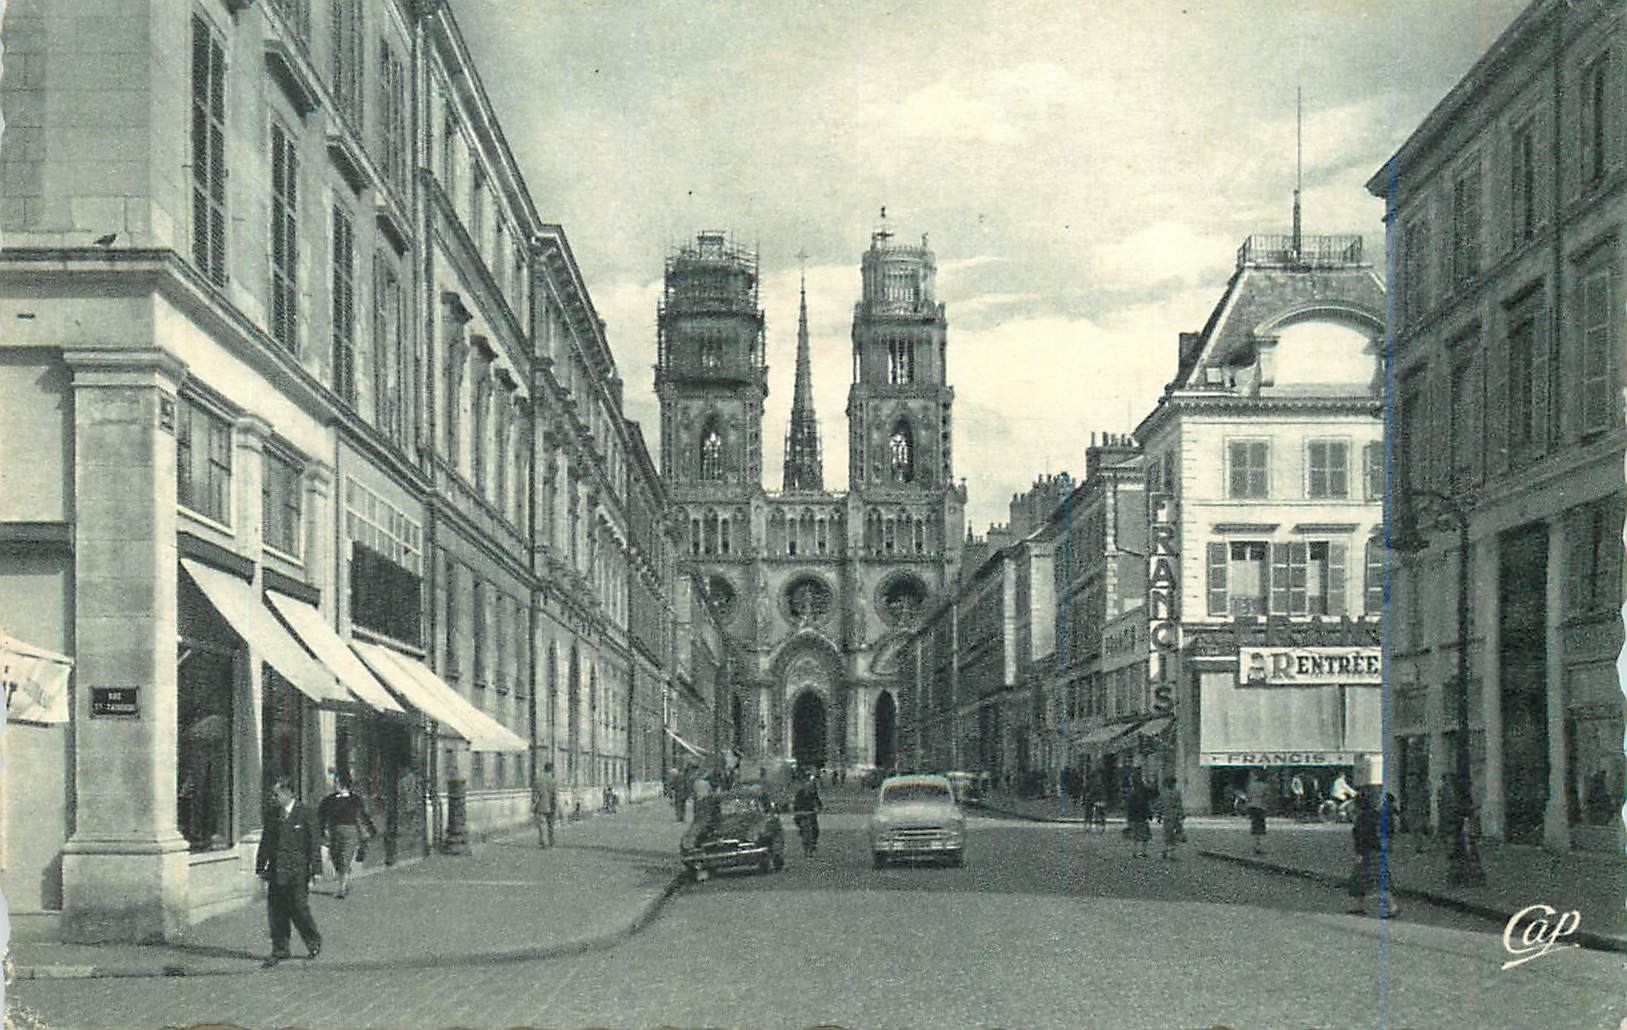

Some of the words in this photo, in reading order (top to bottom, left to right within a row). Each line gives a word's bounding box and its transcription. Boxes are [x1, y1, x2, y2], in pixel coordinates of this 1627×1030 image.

[1152, 498, 1177, 714] FRANCIS
[1234, 615, 1381, 647] FRAN
[1270, 651, 1379, 680] RENTRÉE
[1228, 753, 1326, 764] FRANCIS
